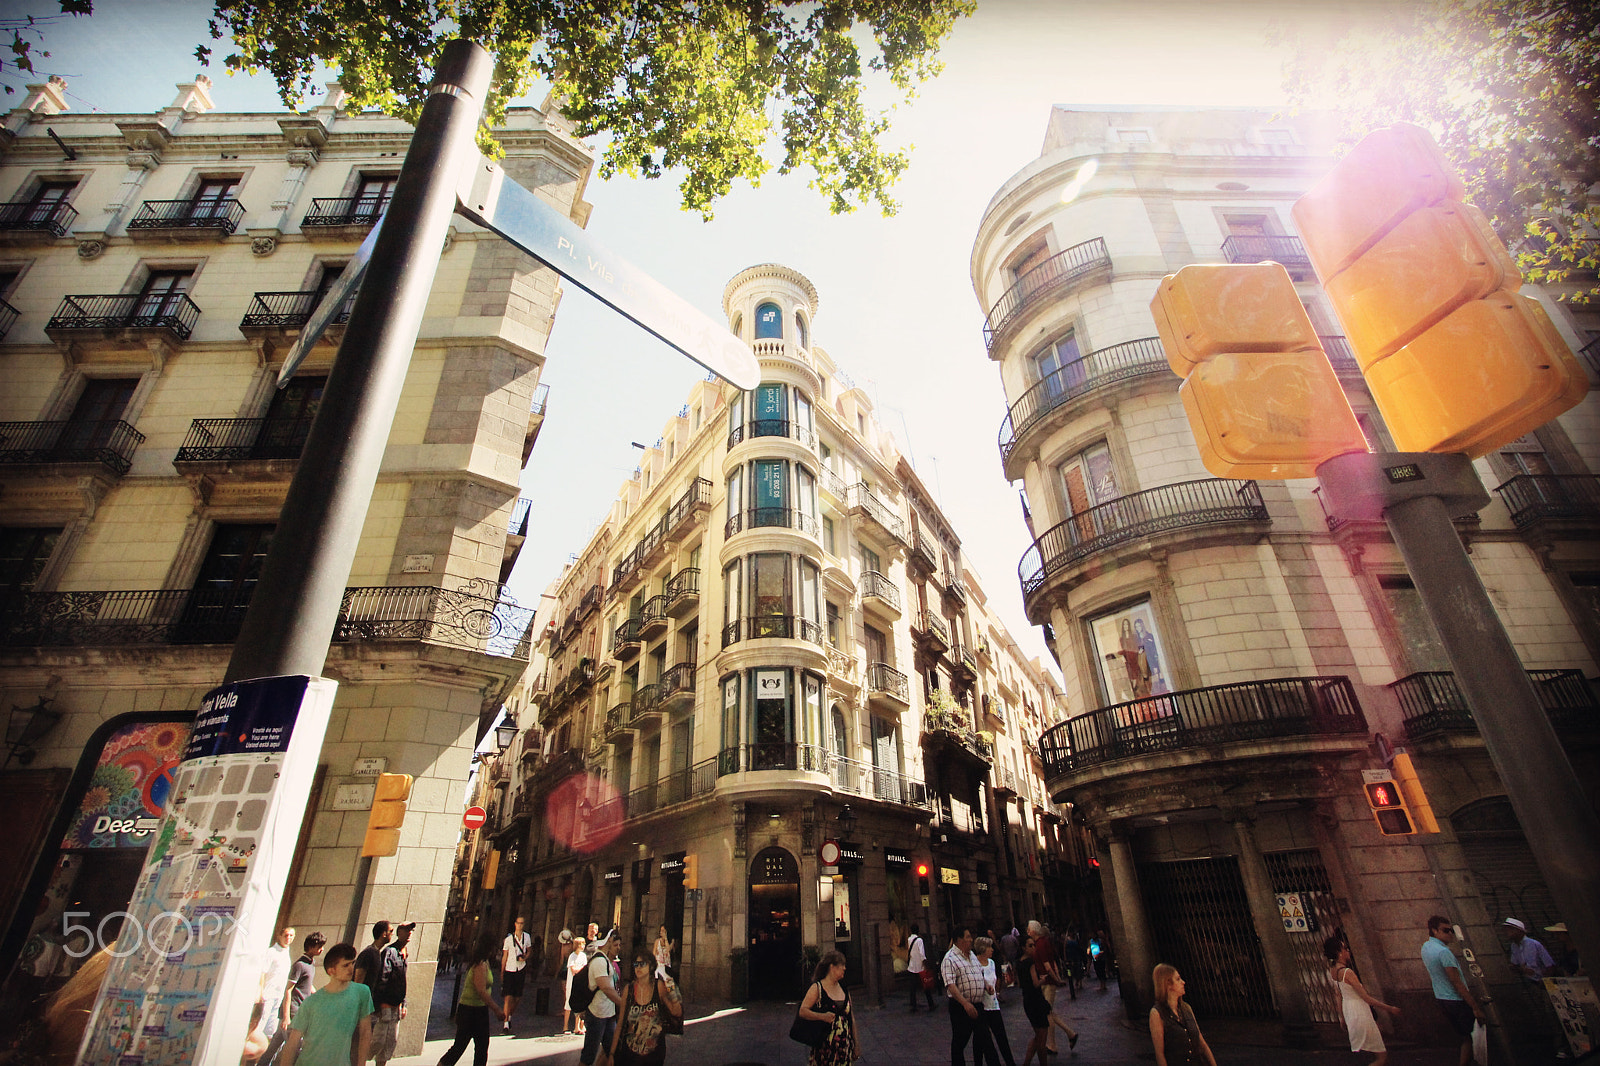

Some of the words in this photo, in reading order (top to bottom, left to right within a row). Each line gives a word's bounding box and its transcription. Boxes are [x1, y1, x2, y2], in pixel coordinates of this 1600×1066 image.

[557, 236, 577, 260] Pl.
[587, 255, 615, 284] Vila
[215, 692, 239, 710] Vella
[840, 850, 864, 859] TUALS...
